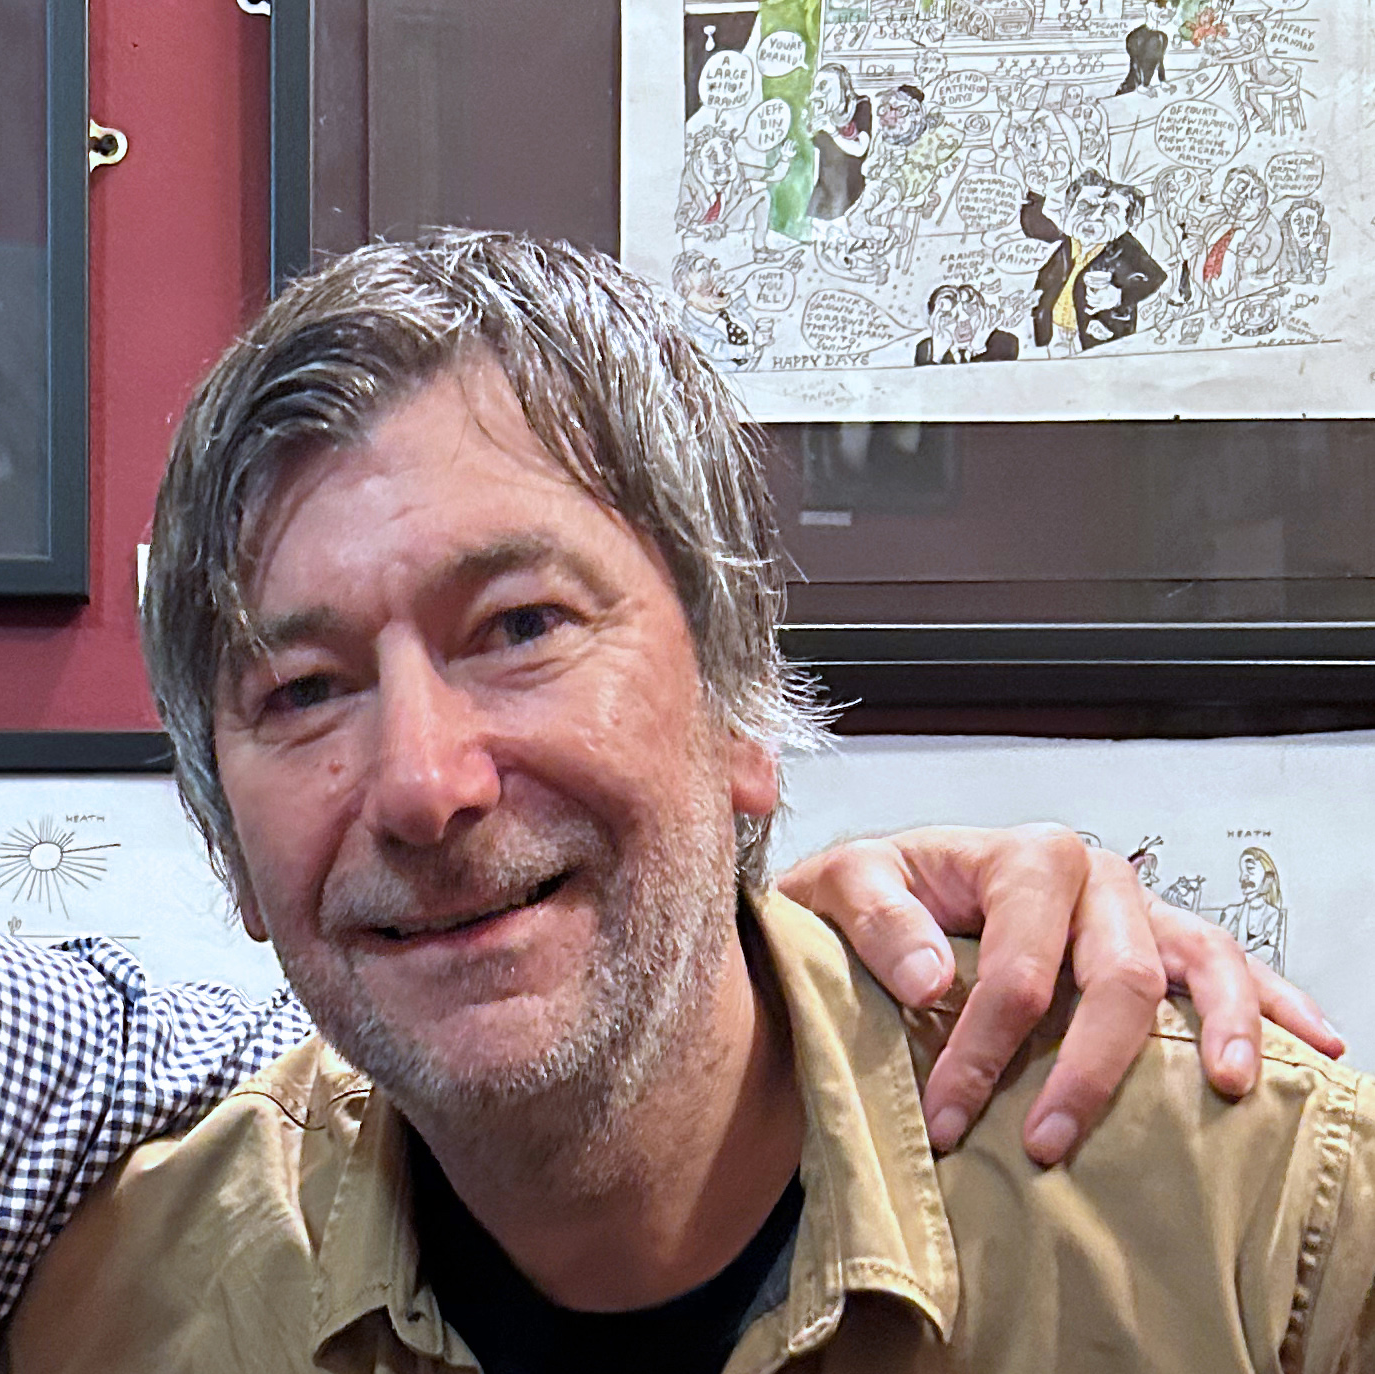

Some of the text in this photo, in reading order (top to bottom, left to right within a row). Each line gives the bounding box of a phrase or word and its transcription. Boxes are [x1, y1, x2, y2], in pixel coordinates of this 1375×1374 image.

[722, 56, 730, 66] A
[706, 68, 747, 80] LARGE
[758, 103, 783, 118] JEFF
[758, 272, 784, 281] HATE
[758, 281, 783, 296] YOU
[772, 353, 869, 369] HAPPY DAYS
[65, 814, 105, 823] HEATH
[1227, 829, 1272, 838] HEATH
